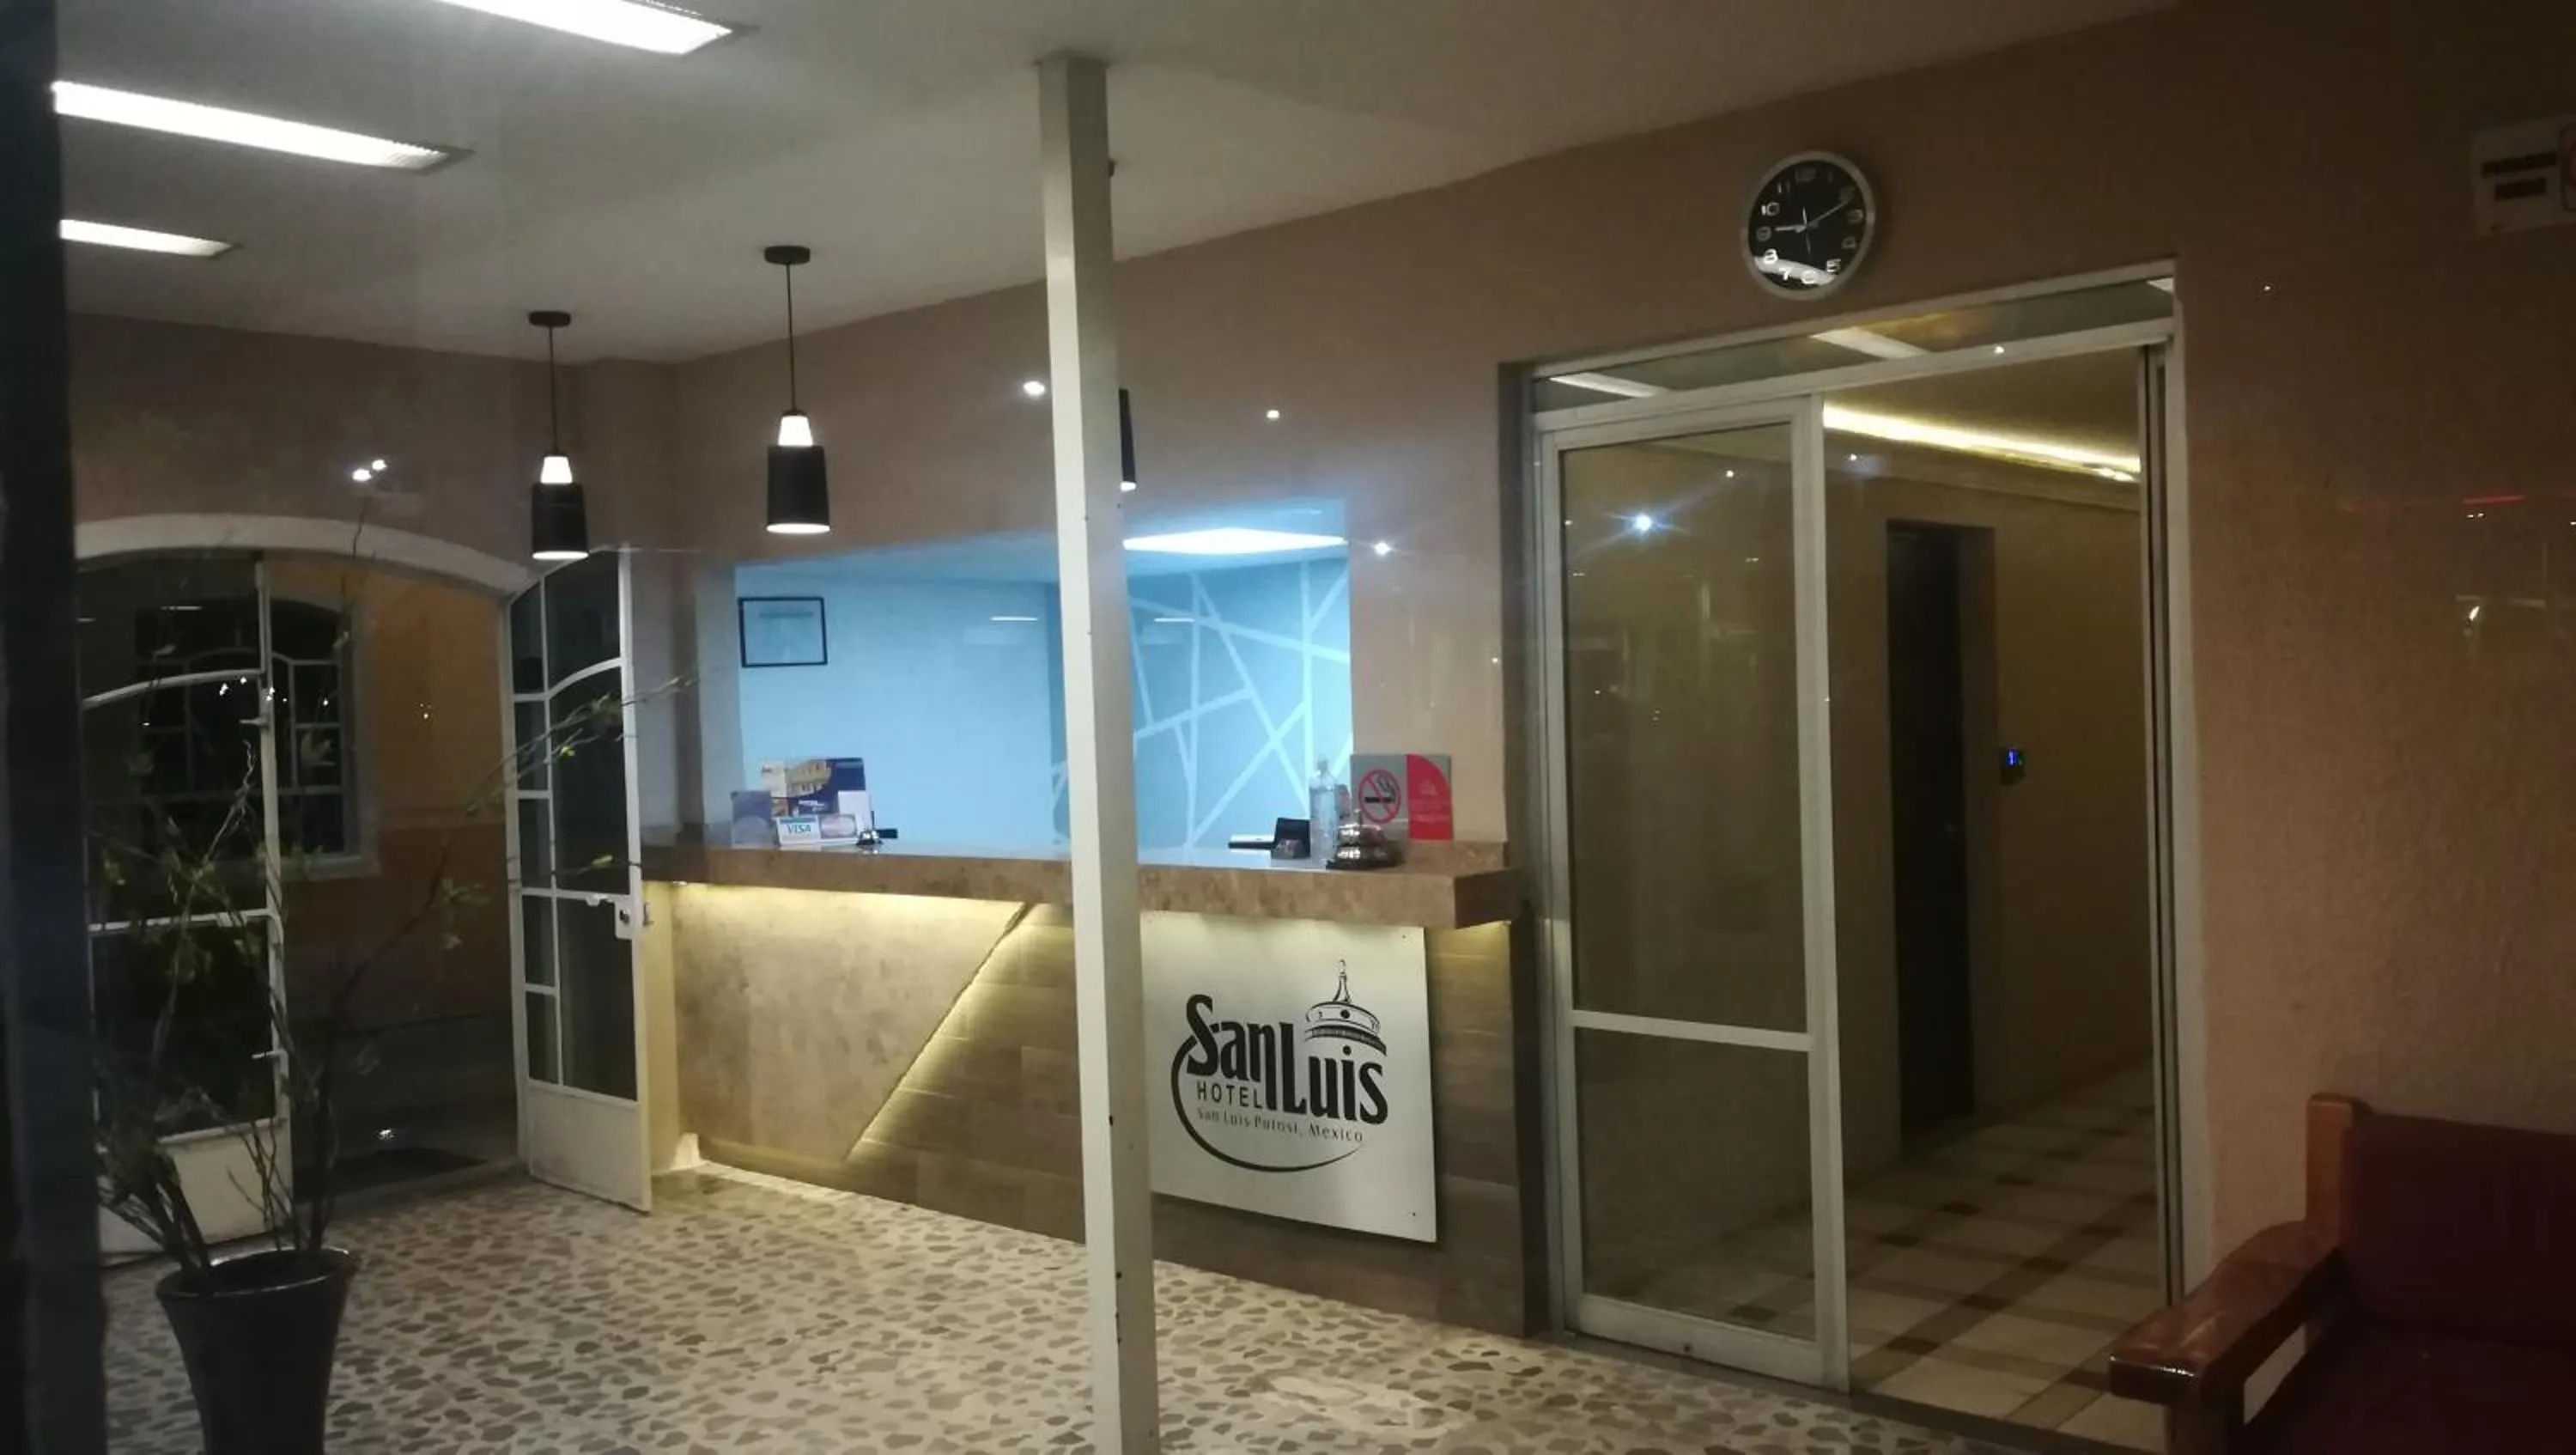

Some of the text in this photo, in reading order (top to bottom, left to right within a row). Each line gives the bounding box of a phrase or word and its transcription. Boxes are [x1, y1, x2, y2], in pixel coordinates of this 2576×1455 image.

[1761, 202, 1780, 216] 10
[786, 824, 811, 834] VISA
[1197, 1081, 1263, 1109] HOTEL
[1197, 1107, 1219, 1121] San
[1224, 1110, 1250, 1127] Luis
[1309, 1123, 1363, 1142] Mexico
